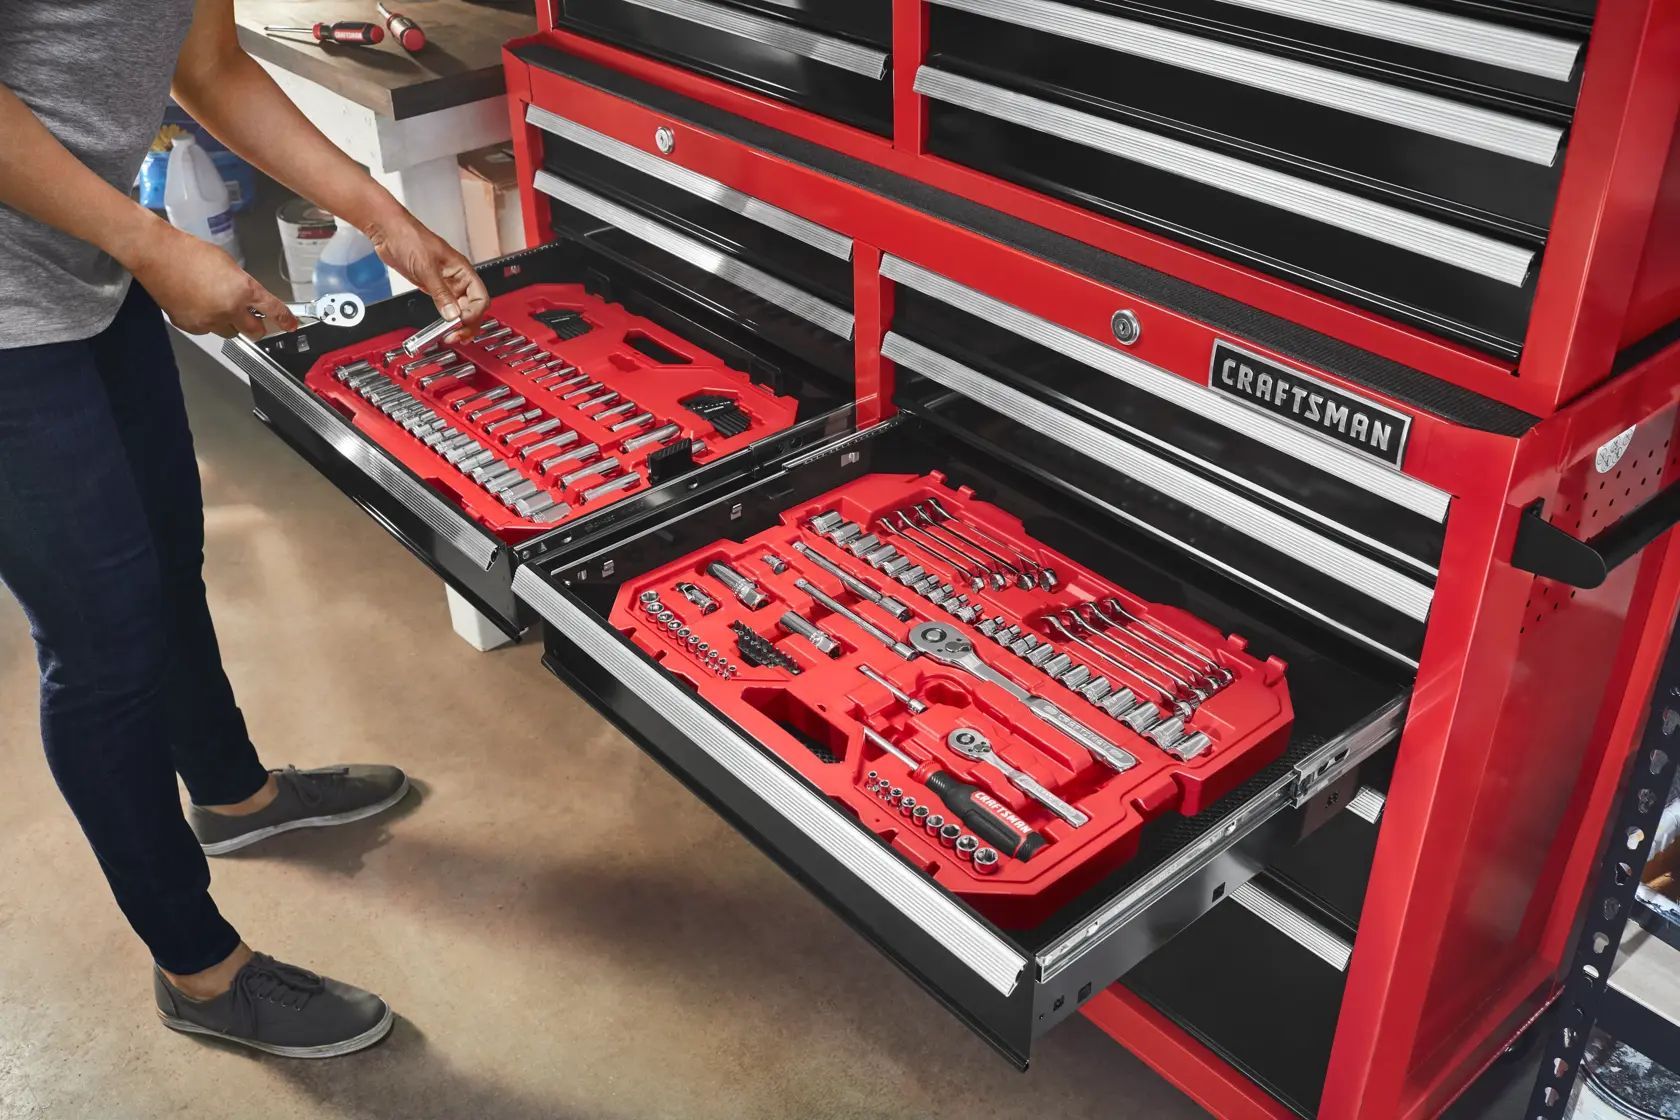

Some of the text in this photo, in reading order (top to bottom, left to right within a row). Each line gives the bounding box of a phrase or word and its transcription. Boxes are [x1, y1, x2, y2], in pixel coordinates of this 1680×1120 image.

[1221, 357, 1392, 452] CRAFTSMAN
[1058, 714, 1110, 750] CRAFTSMAN
[974, 791, 1033, 834] CRAFTSMAN
